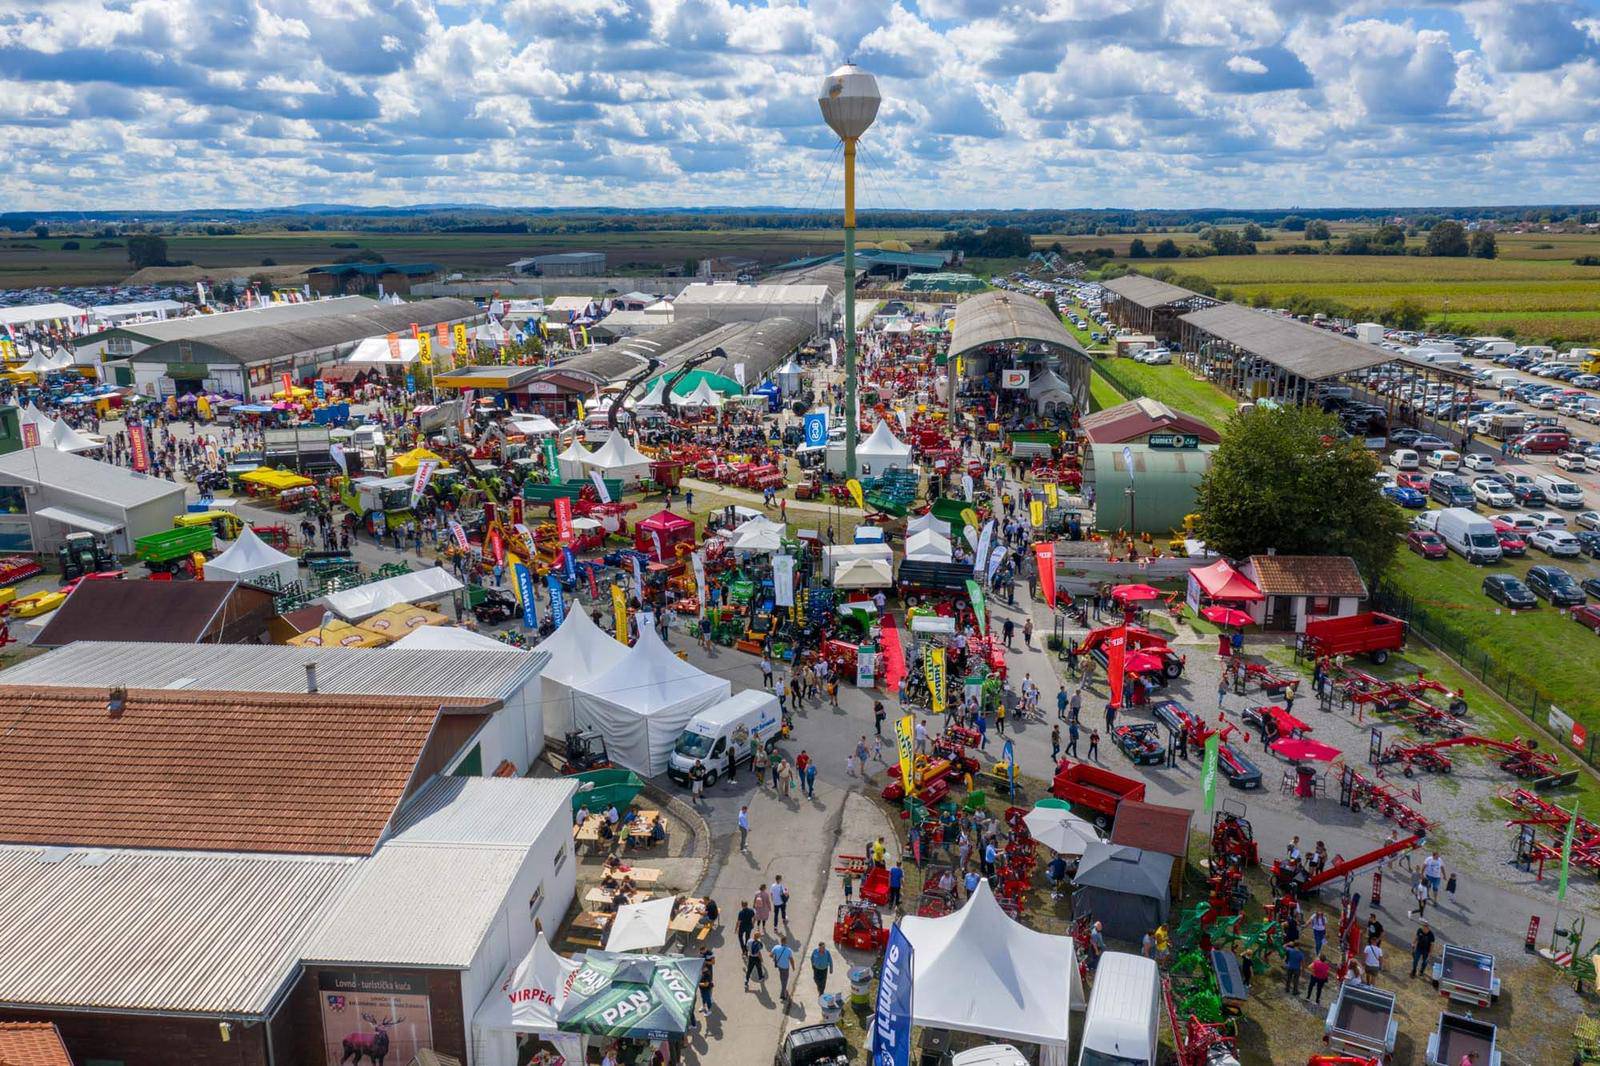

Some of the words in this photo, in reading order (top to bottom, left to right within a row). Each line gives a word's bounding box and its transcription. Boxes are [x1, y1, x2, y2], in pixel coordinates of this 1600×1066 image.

[336, 979, 356, 987] Lovno
[580, 969, 609, 987] PAN
[658, 969, 691, 1002] PAN
[509, 989, 555, 1006] VIRPEK
[601, 990, 648, 1025] PAN
